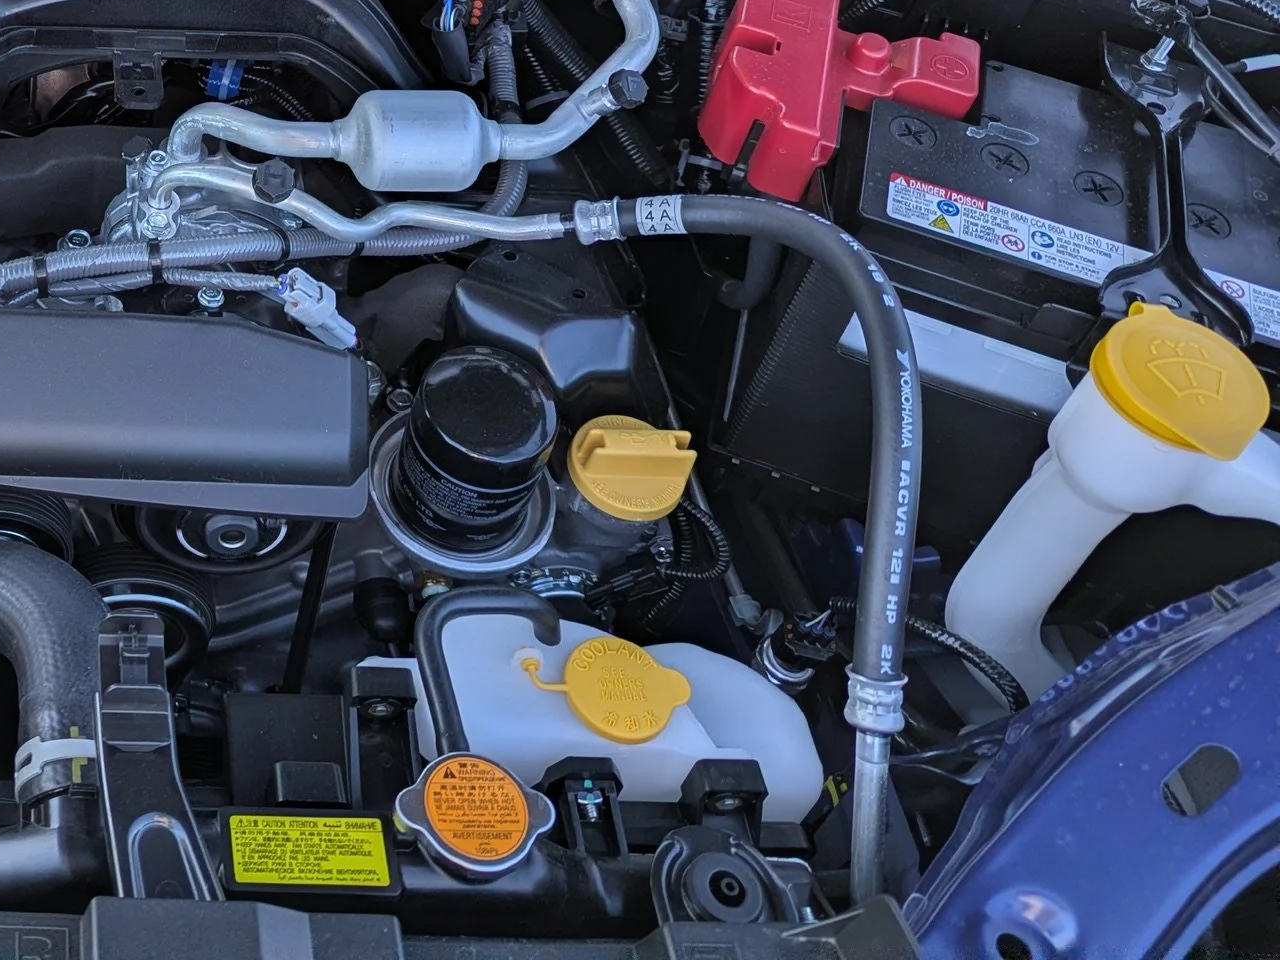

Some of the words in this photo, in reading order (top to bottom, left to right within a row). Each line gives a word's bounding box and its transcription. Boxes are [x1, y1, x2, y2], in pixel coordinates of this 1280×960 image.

[909, 179, 945, 198] DANGER
[951, 192, 985, 210] POISON
[962, 211, 981, 221] REACH
[990, 220, 1018, 234] CHILDREN
[963, 206, 977, 215] KEEP
[978, 210, 990, 218] OUT
[1030, 219, 1046, 231] CCA
[1047, 224, 1066, 236] 660A
[1105, 241, 1120, 253] 12V
[1056, 236, 1072, 246] READ
[1072, 241, 1112, 259] INSTRUCTIONS
[1056, 249, 1096, 266] INSTRUCTIONS
[898, 366, 913, 449] YOKOHAMA
[440, 478, 478, 499] CAUTION
[894, 471, 910, 537] ACVR
[887, 594, 900, 625] HP
[573, 640, 658, 672] COOLANT
[880, 643, 893, 675] 2K
[602, 667, 626, 679] SEE
[600, 689, 647, 702] MANUAL
[261, 819, 287, 829] CAUTION
[288, 820, 319, 829] ATTENTION
[452, 831, 513, 841] AVERTISSEMENT
